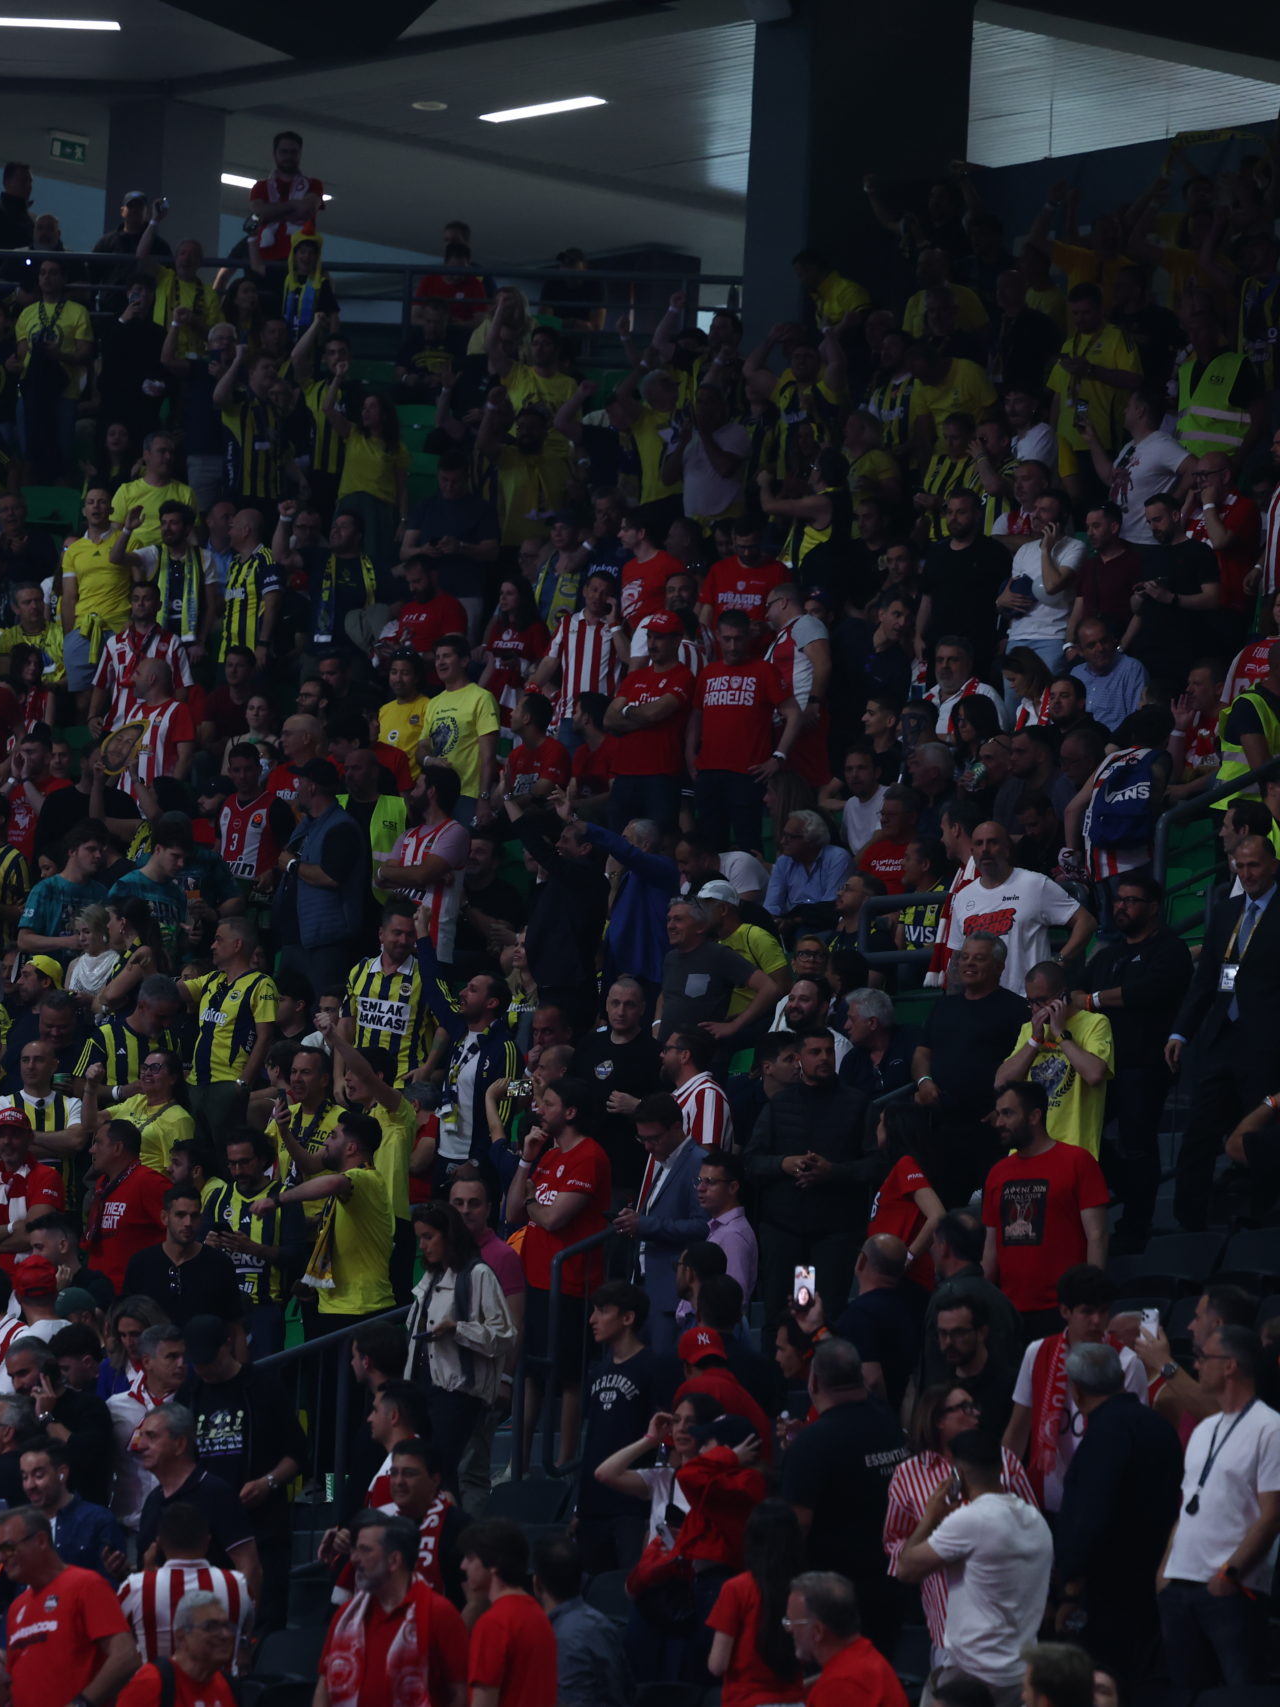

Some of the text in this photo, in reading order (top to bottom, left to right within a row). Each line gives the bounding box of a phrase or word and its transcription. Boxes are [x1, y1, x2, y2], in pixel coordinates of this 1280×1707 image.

[705, 675, 757, 693] THIS IS
[703, 690, 755, 707] PIRAEUS
[1102, 782, 1152, 804] VANS
[382, 820, 398, 831] CSI
[229, 831, 240, 852] 3
[871, 858, 905, 868] OLYMPIAC
[1002, 894, 1020, 902] bwin
[904, 924, 939, 943] AVIS
[360, 1000, 404, 1018] EMLAK
[358, 1012, 408, 1033] BANKASI
[696, 1331, 711, 1345] NY
[863, 1446, 911, 1468] ESSENTI
